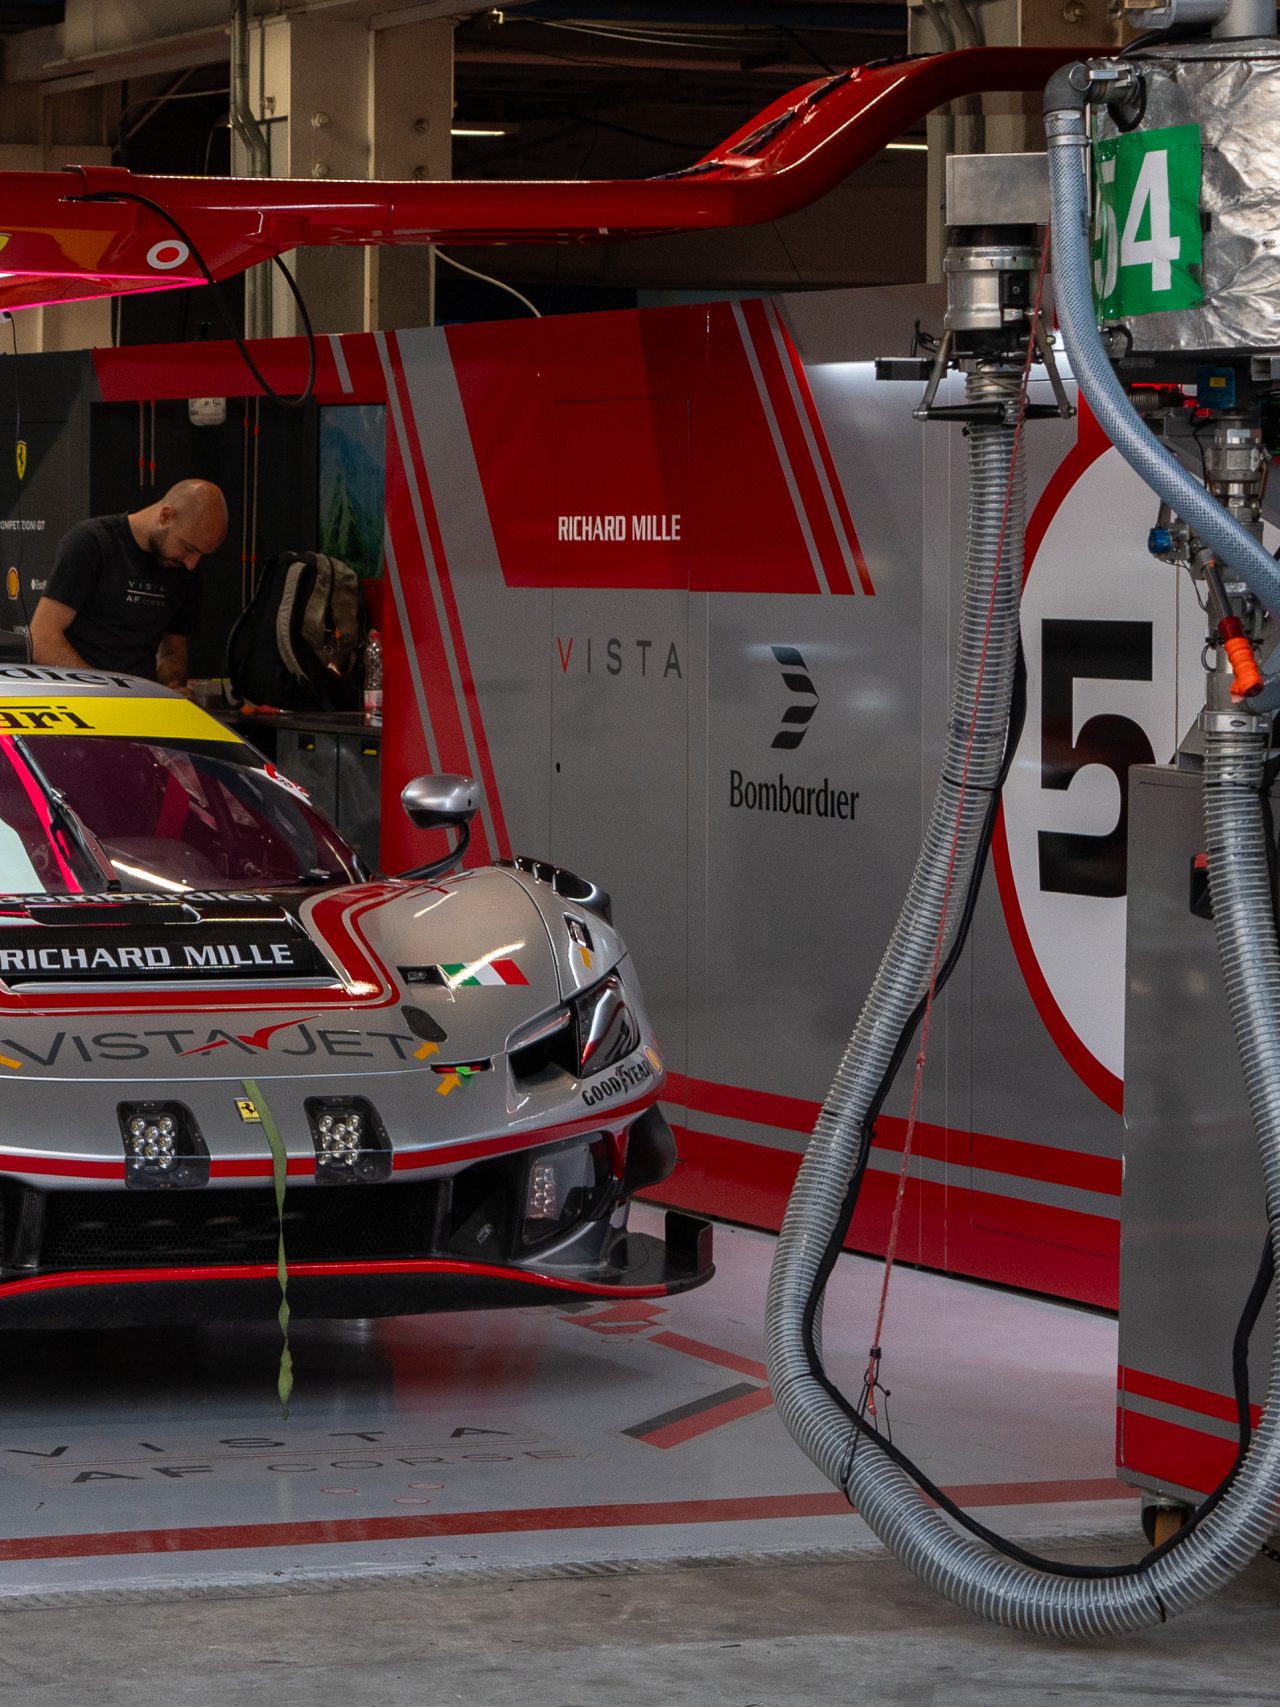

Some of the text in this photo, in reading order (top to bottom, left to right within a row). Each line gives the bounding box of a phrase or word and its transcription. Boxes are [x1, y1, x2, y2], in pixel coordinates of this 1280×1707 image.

[558, 514, 681, 541] RICHARD MILLE
[128, 580, 166, 592] VISA
[556, 637, 682, 679] VISTA
[1037, 618, 1157, 898] 5
[729, 769, 860, 820] Bombardier
[0, 944, 294, 972] RICHARD MILLE
[1, 1014, 416, 1067] VISTAJET
[581, 1060, 651, 1107] GOODYEAR
[4, 1426, 515, 1459] VISTA
[70, 1448, 577, 1484] AF CORSE
